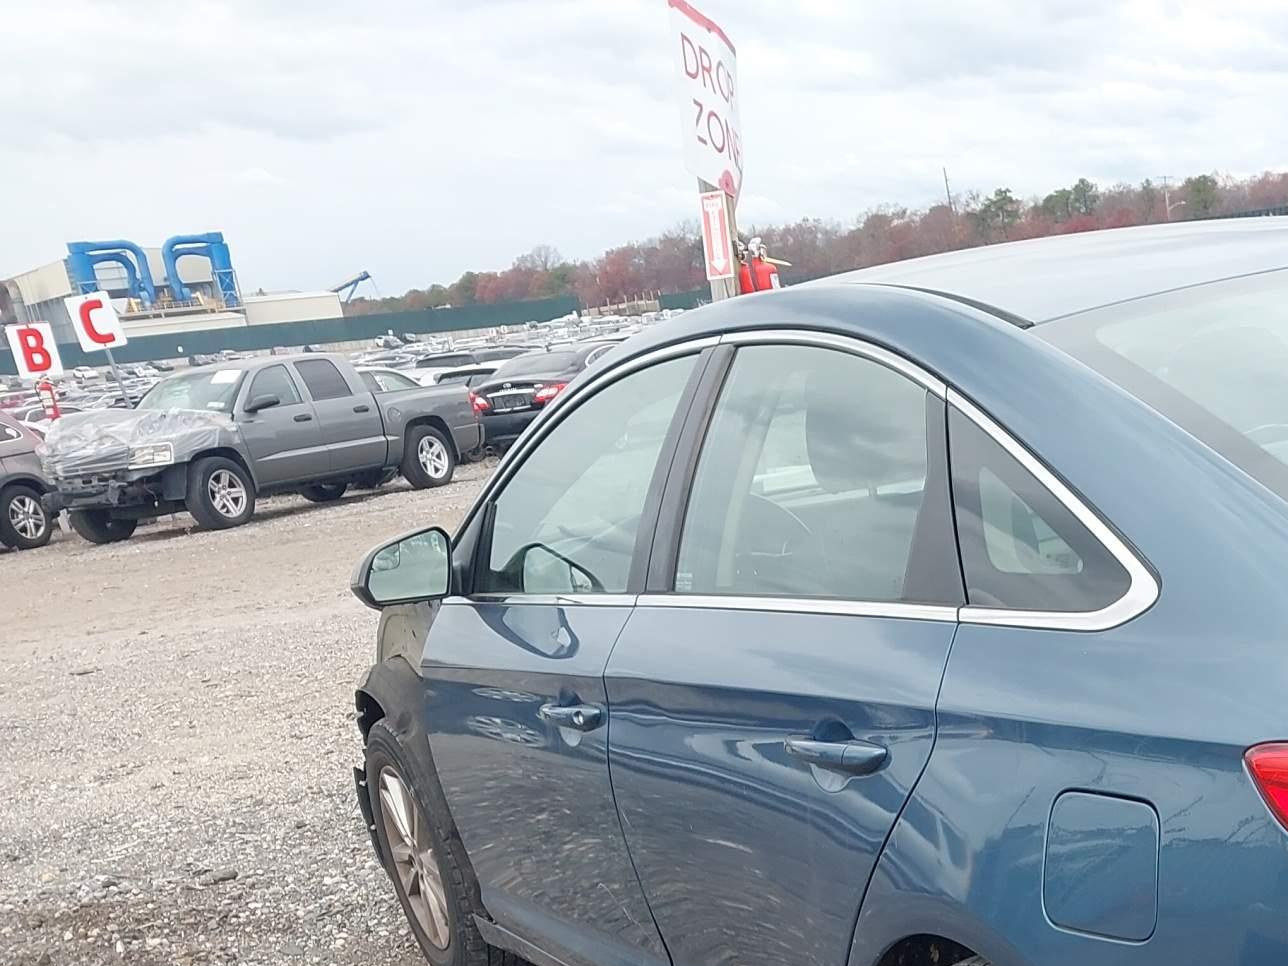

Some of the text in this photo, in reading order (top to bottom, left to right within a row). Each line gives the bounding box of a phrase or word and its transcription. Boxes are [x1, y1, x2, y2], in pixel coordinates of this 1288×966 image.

[680, 32, 735, 111] DROP
[693, 98, 743, 174] ZONE
[16, 328, 52, 372] B
[79, 299, 116, 344] C
